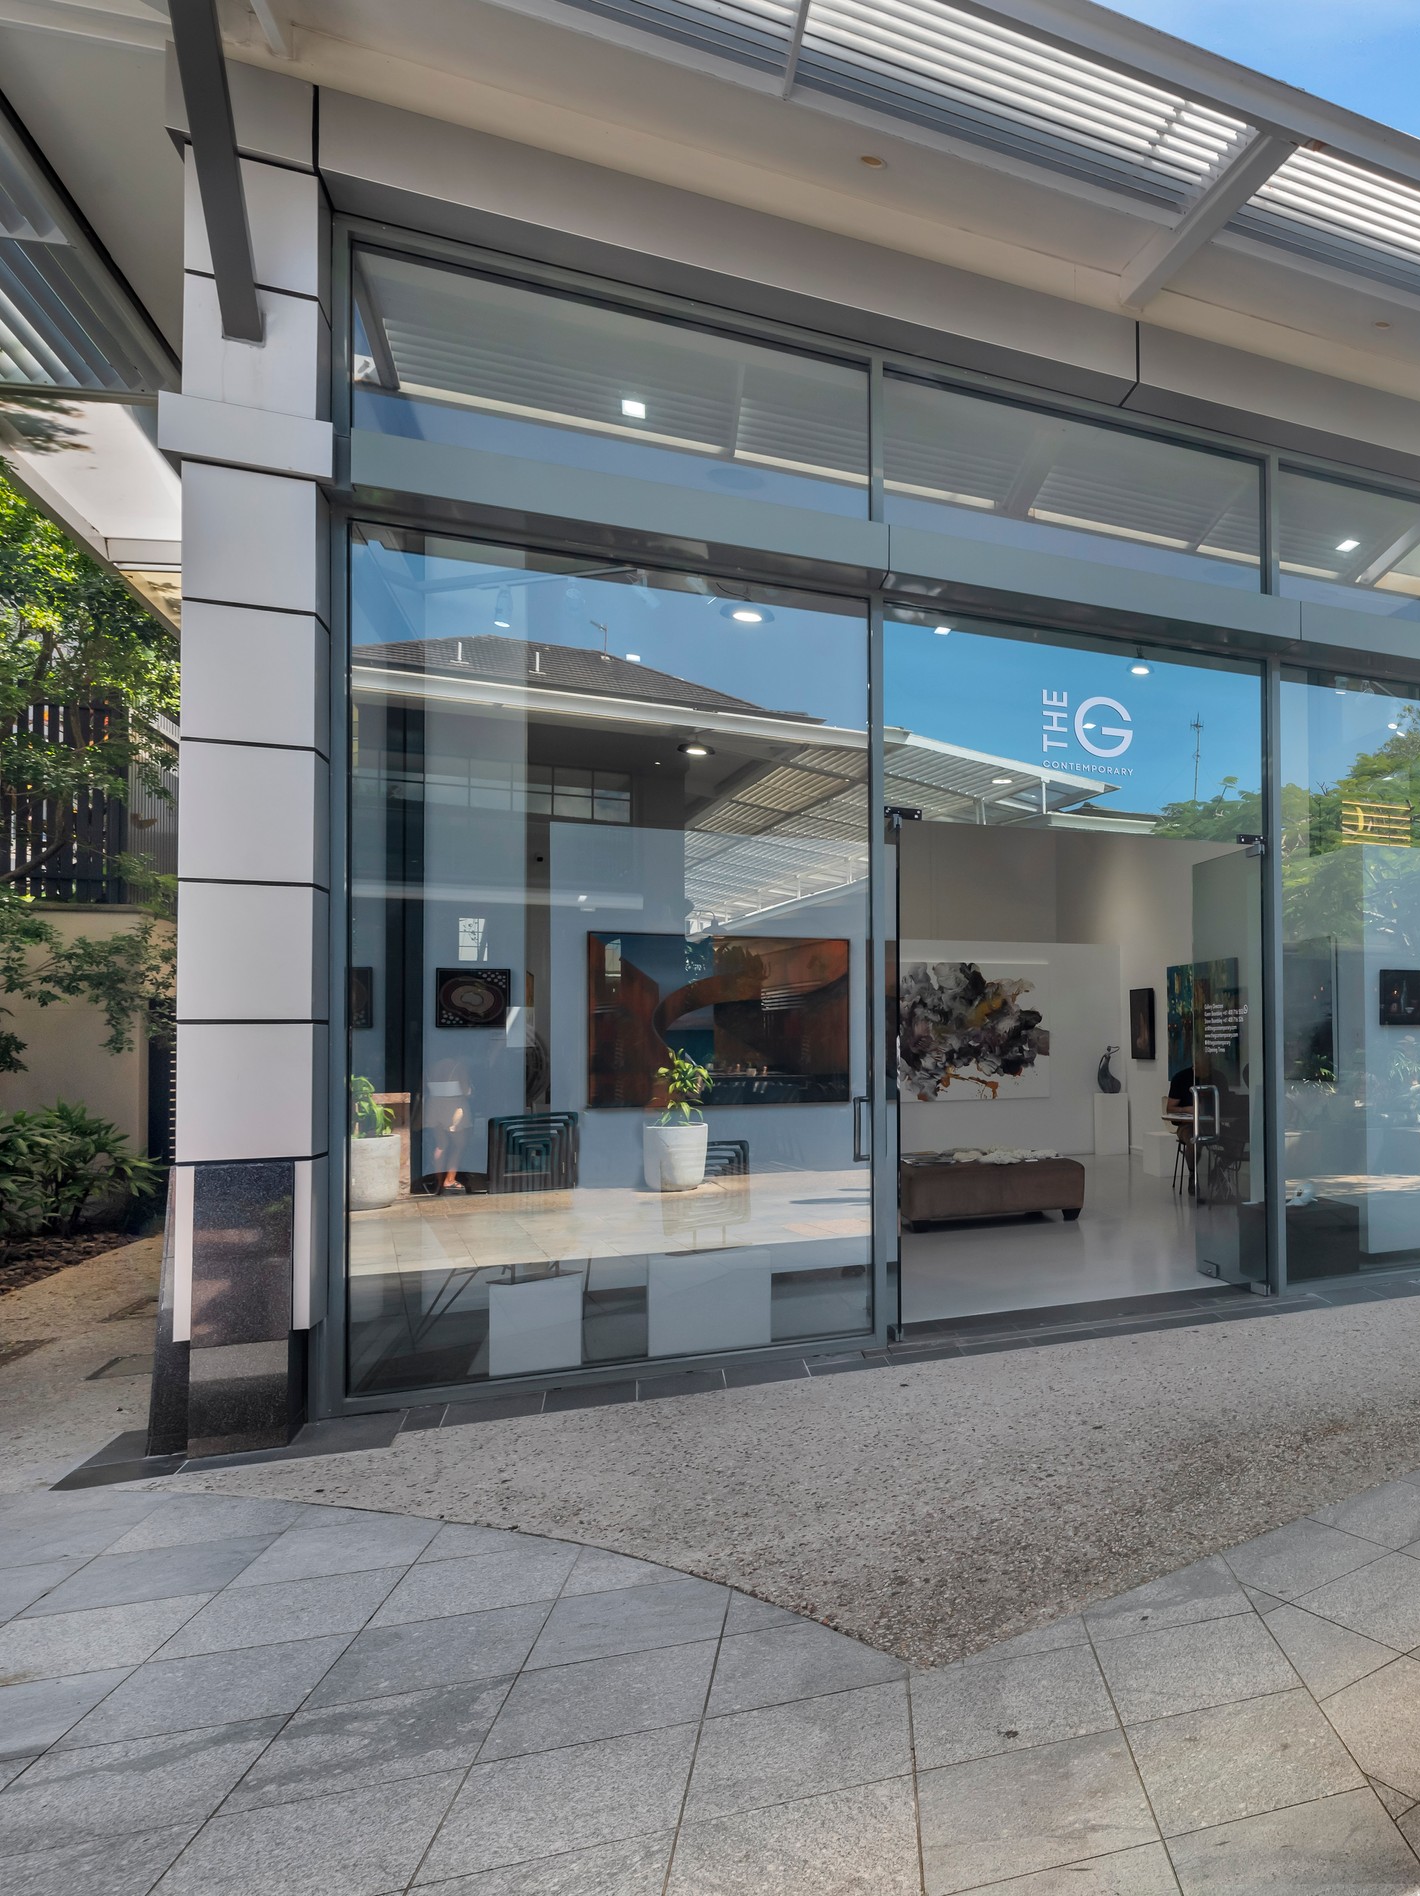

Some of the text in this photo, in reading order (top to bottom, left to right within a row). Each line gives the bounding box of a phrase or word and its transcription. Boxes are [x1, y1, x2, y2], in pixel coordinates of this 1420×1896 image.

[1042, 689, 1068, 752] THE
[1074, 696, 1133, 758] G
[1042, 759, 1134, 776] CONTEMPORARY
